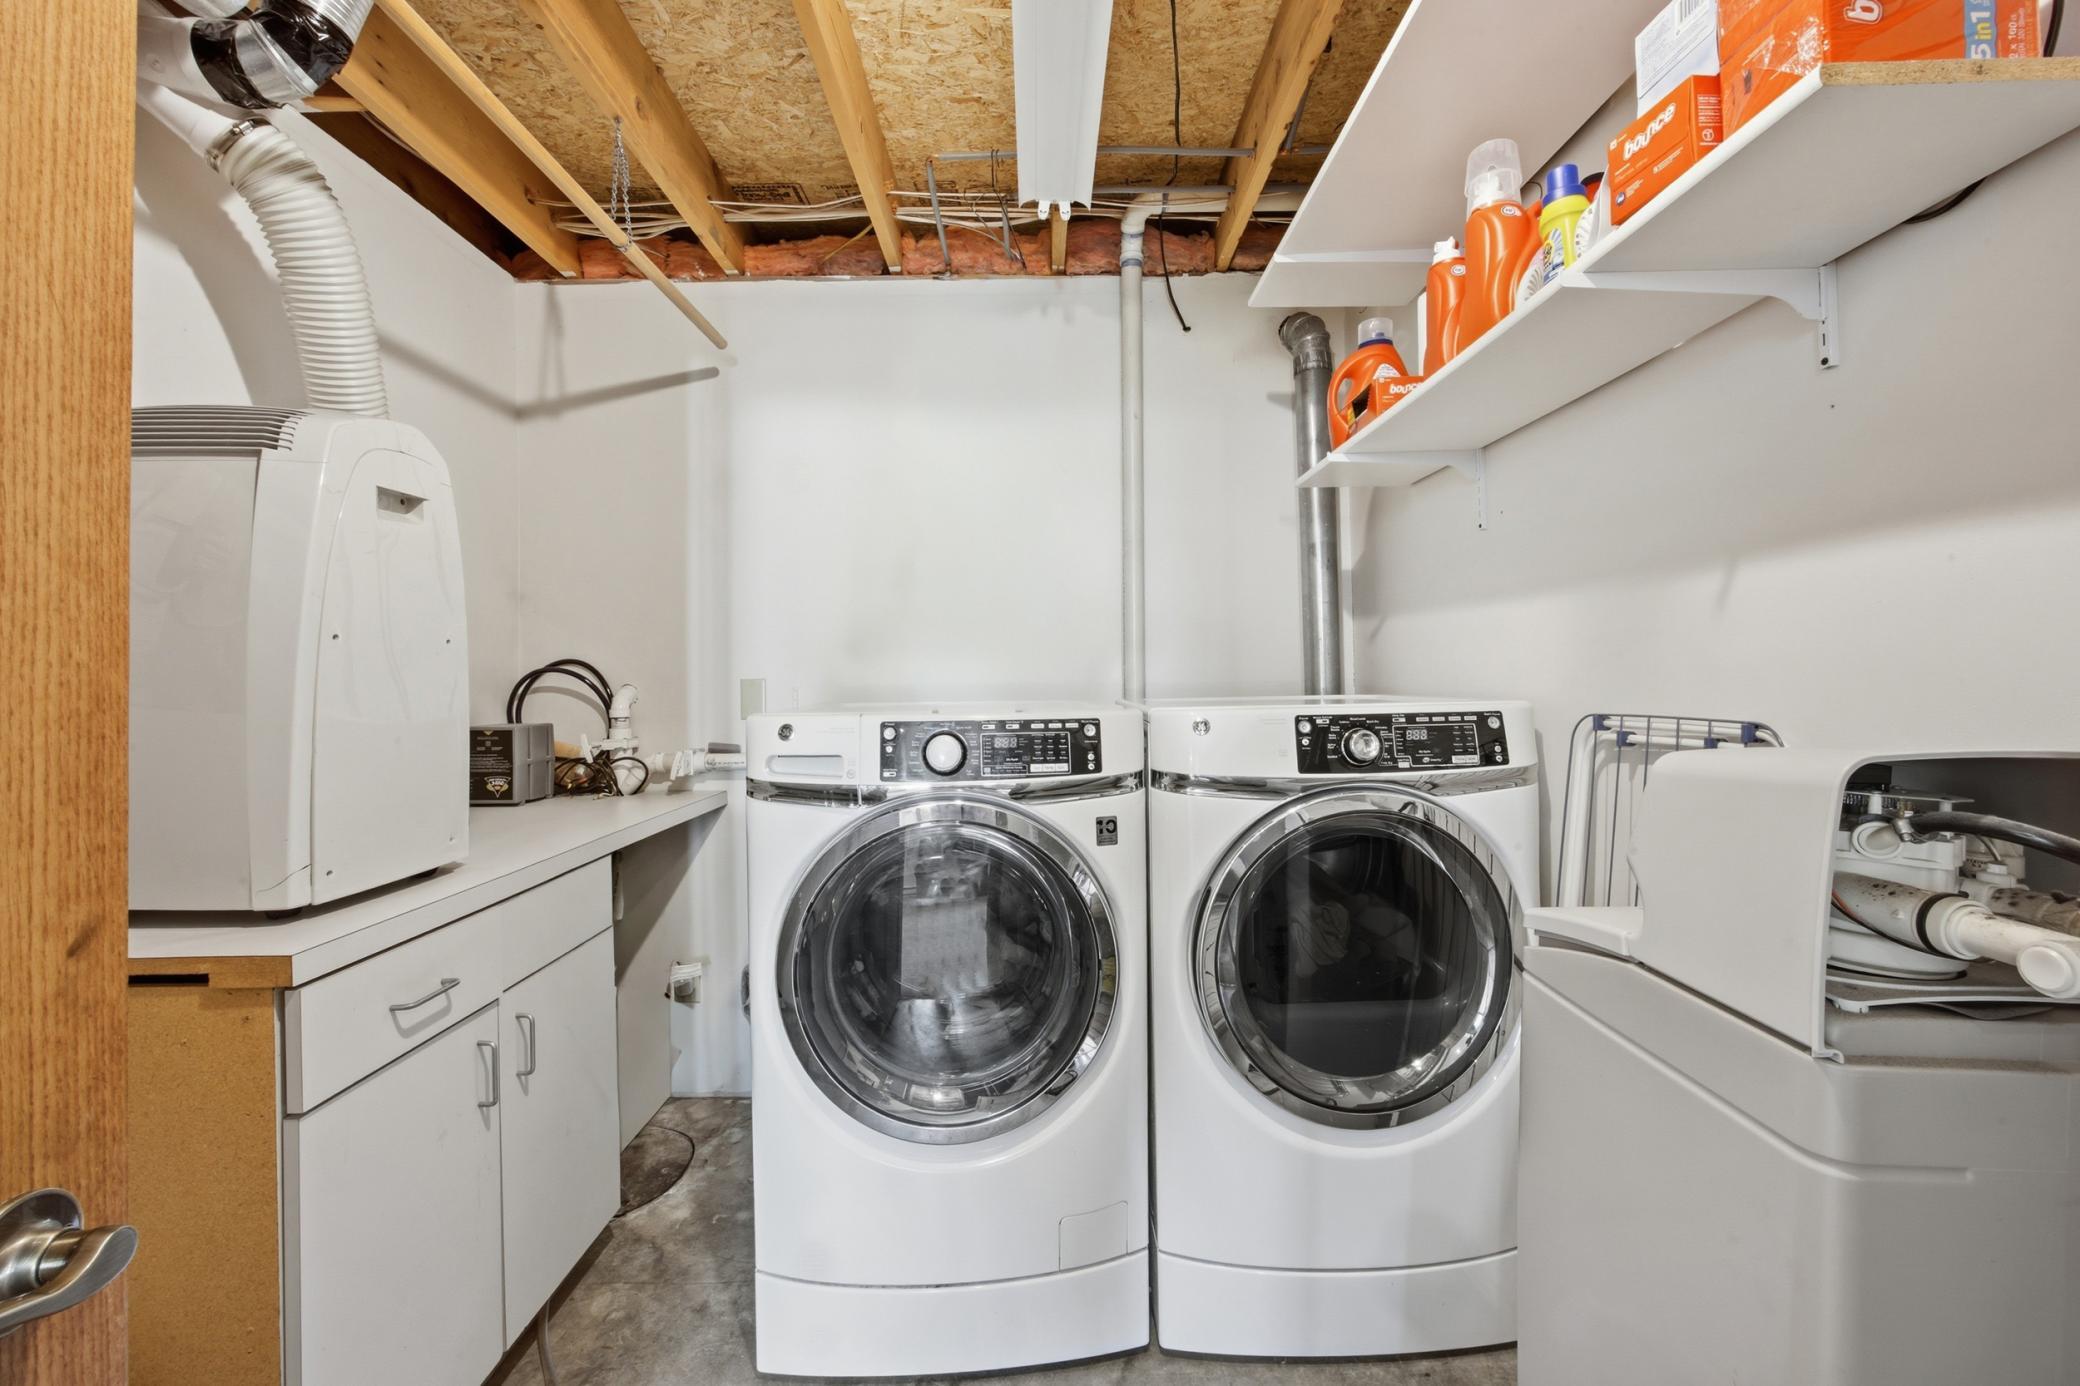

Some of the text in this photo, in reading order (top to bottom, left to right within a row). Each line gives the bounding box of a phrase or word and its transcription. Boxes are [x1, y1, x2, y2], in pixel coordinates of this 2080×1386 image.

[1970, 11, 1991, 23] 1
[1975, 22, 1992, 40] in
[1623, 102, 1677, 160] bounce
